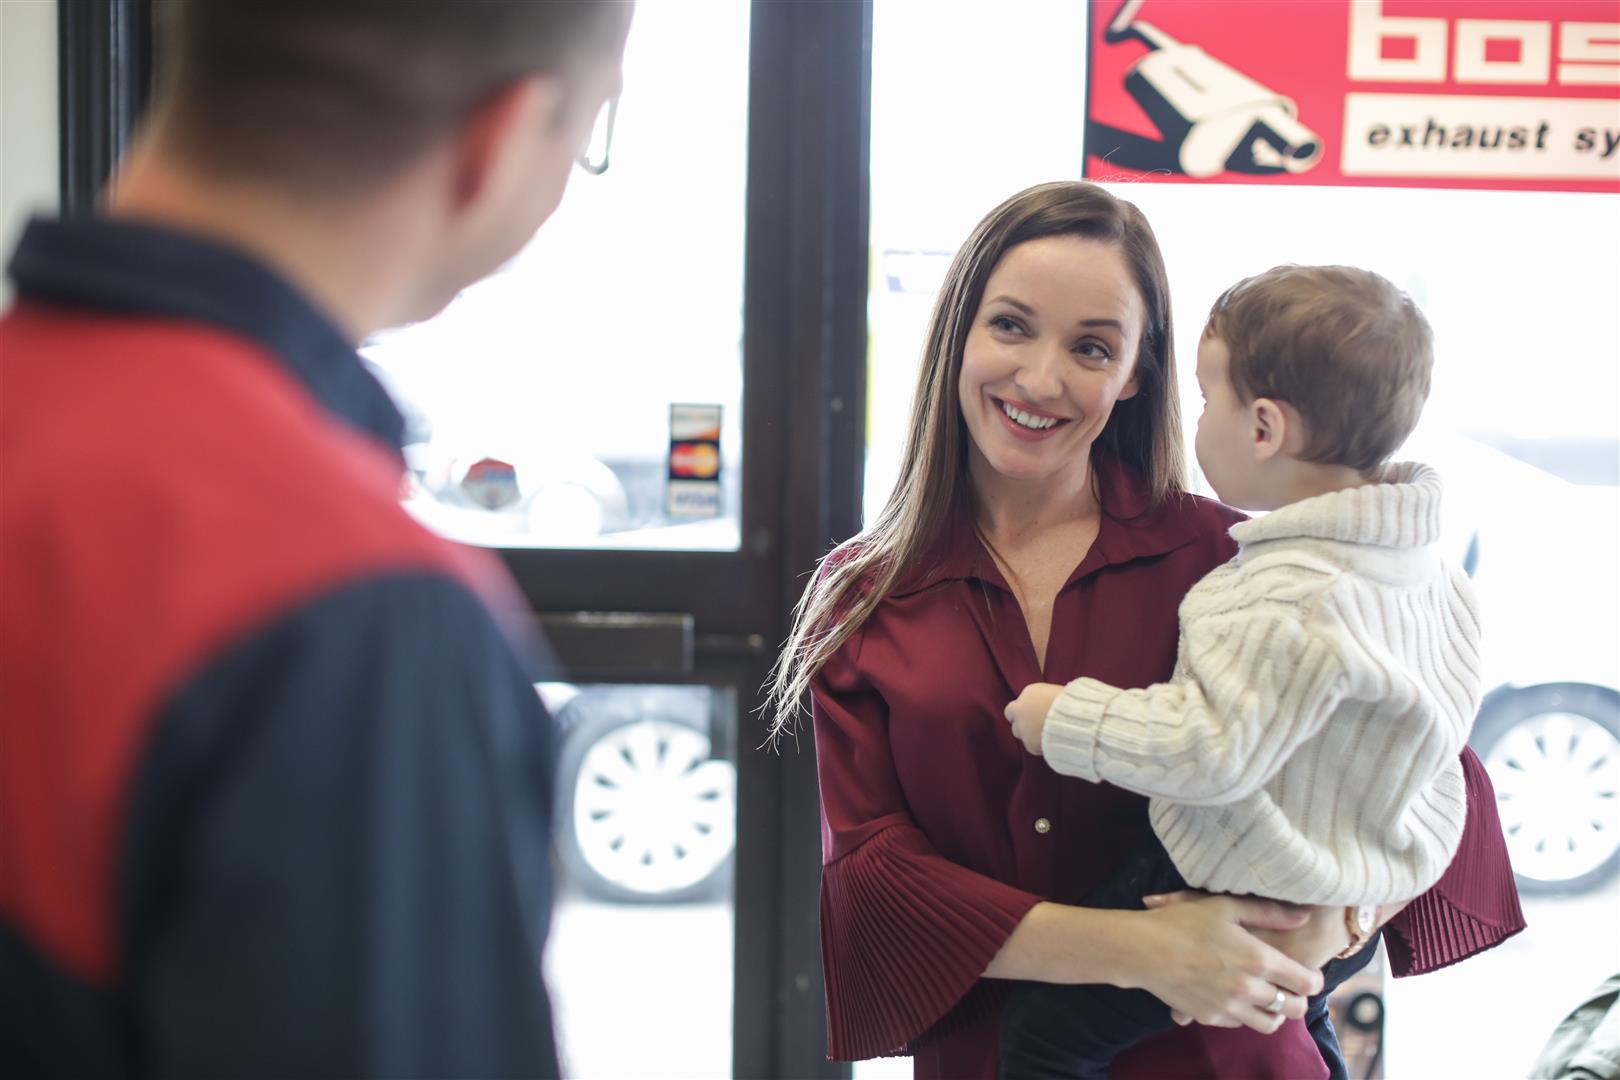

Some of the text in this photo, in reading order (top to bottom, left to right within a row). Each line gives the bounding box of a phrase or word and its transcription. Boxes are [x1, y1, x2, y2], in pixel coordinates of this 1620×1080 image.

[1346, 0, 1620, 85] bos
[1367, 118, 1620, 160] exhaust sy
